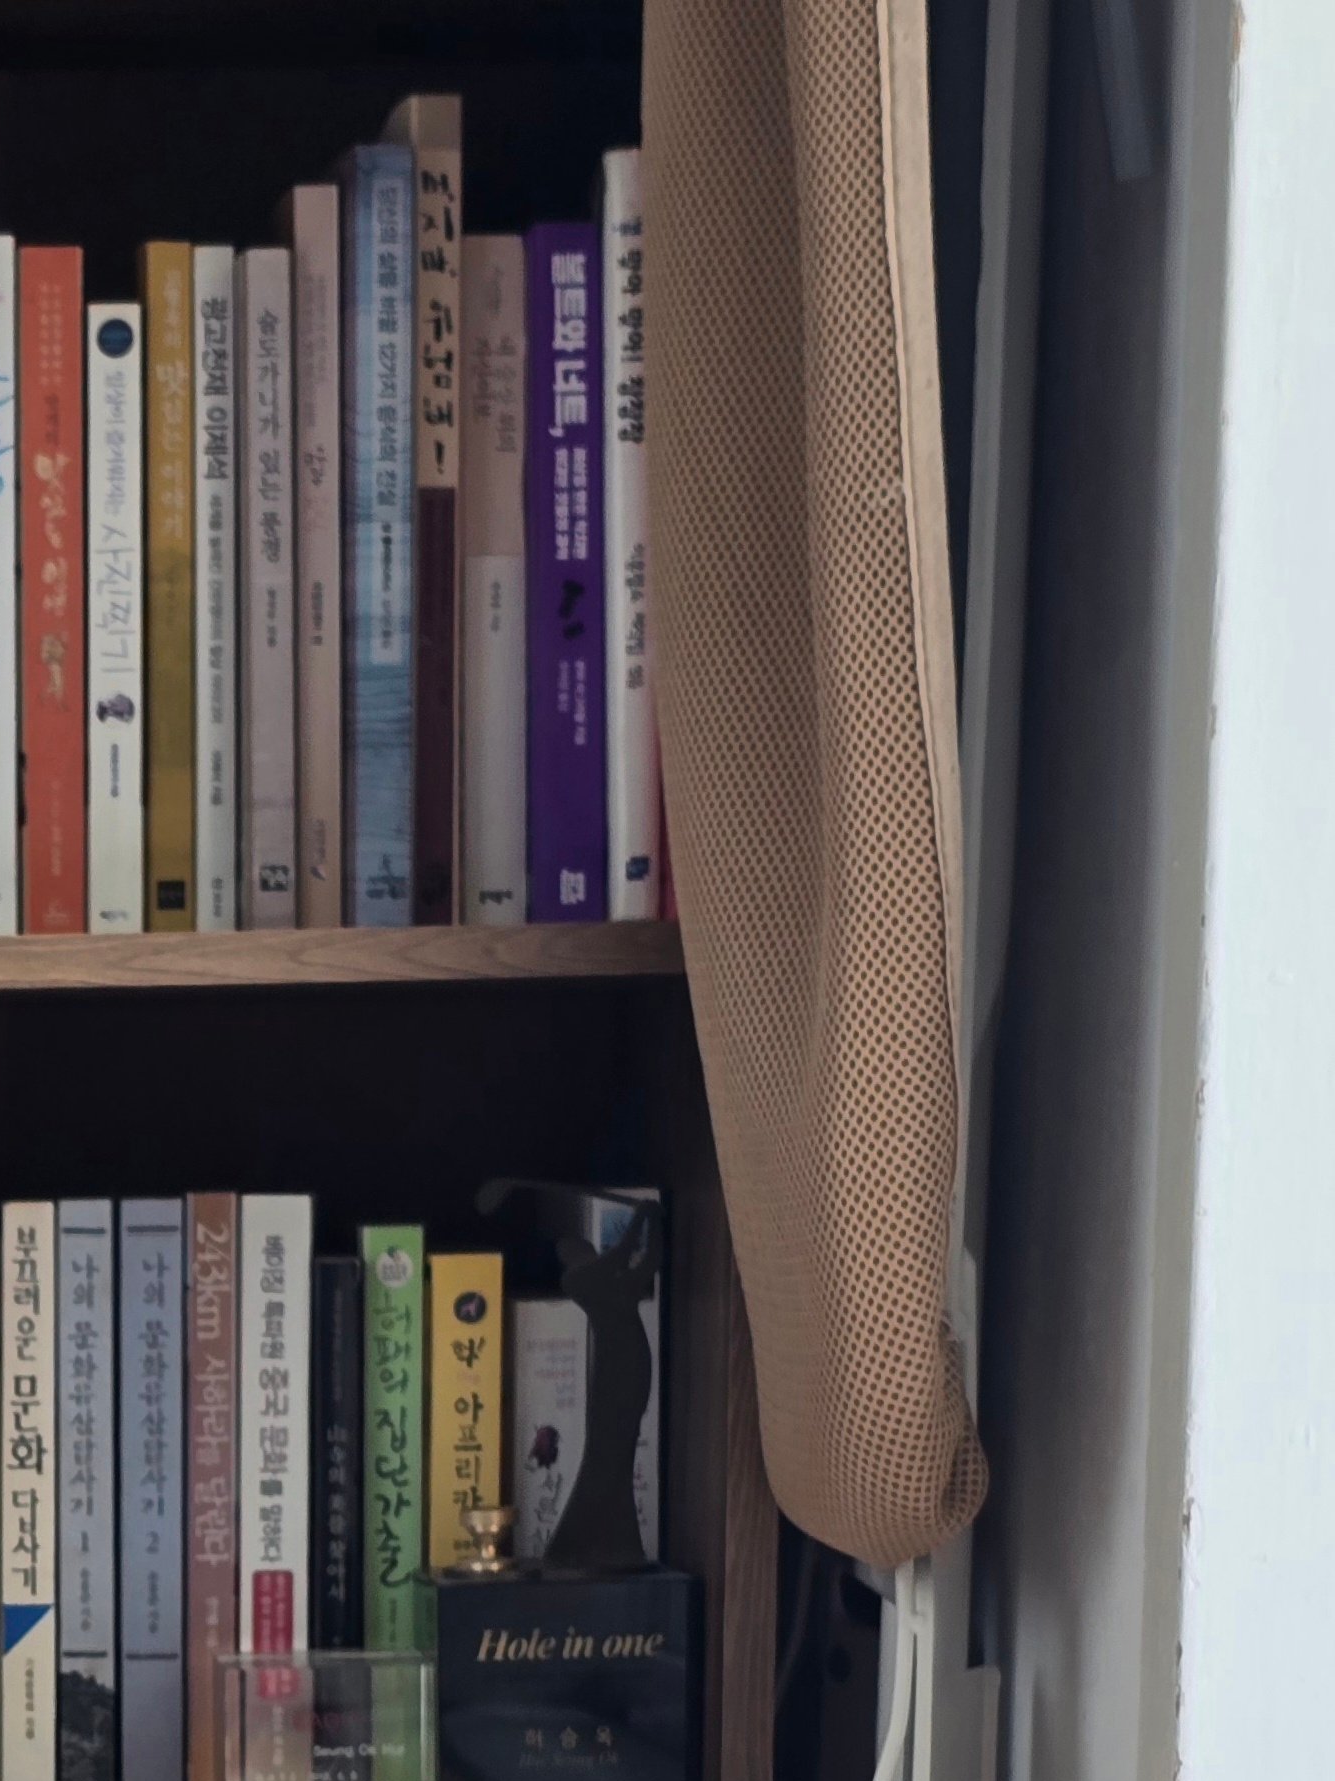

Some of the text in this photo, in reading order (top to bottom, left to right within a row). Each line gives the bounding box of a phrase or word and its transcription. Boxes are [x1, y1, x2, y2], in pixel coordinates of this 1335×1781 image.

[200, 296, 230, 481] 광고천재 이제석
[548, 252, 587, 438] 볼트와 너트,
[195, 1222, 232, 1341] 243km
[7, 1226, 49, 1598] 부끄러운 문화 답사기
[67, 1252, 101, 1554] 나의 문화유산답사기 1
[137, 1252, 170, 1556] 나의 문화유산답사기 2
[195, 1352, 232, 1466] 사하라를
[258, 1365, 291, 1419] 중국
[374, 1404, 415, 1587] 집단가출
[476, 1624, 665, 1663] Hole in one
